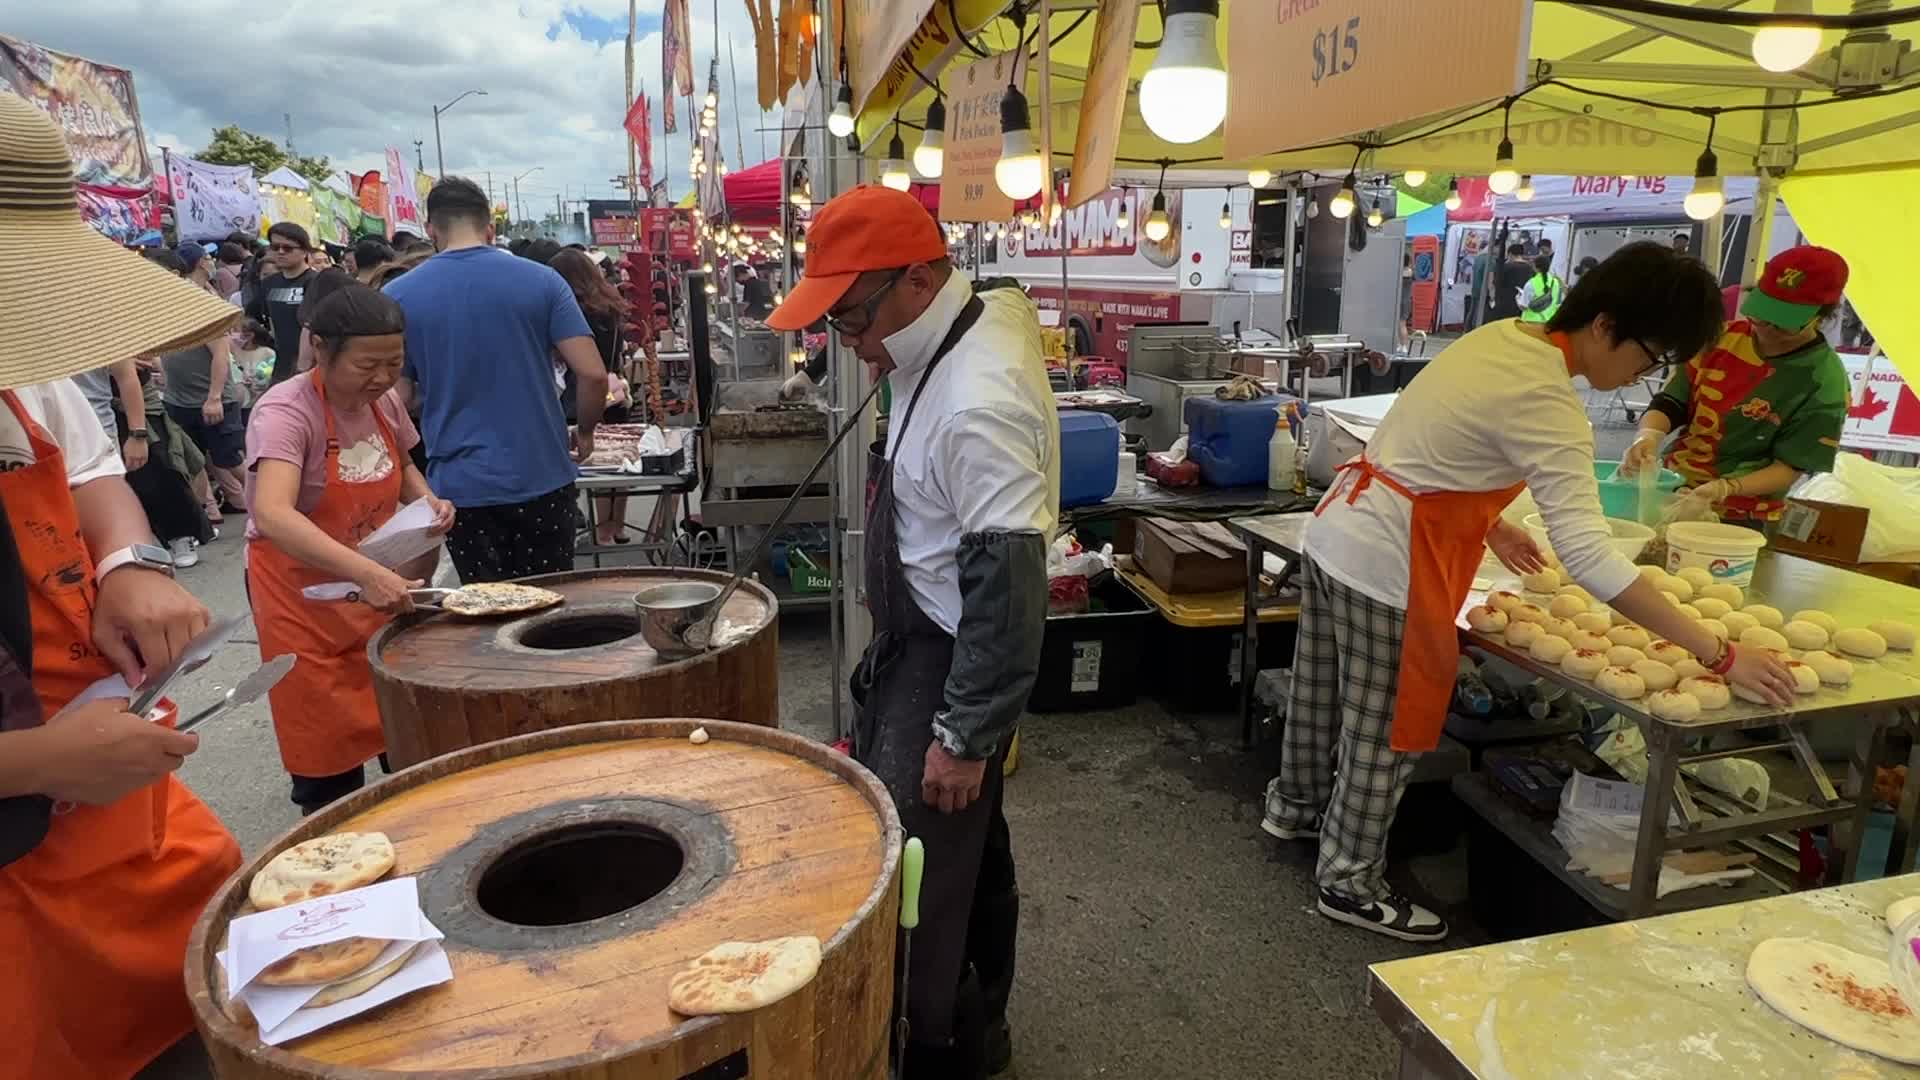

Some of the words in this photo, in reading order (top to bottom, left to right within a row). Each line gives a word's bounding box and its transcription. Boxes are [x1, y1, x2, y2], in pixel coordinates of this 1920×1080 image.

[1311, 16, 1361, 88] $15
[1572, 175, 1632, 197] Mary
[1065, 197, 1137, 249] MAMA
